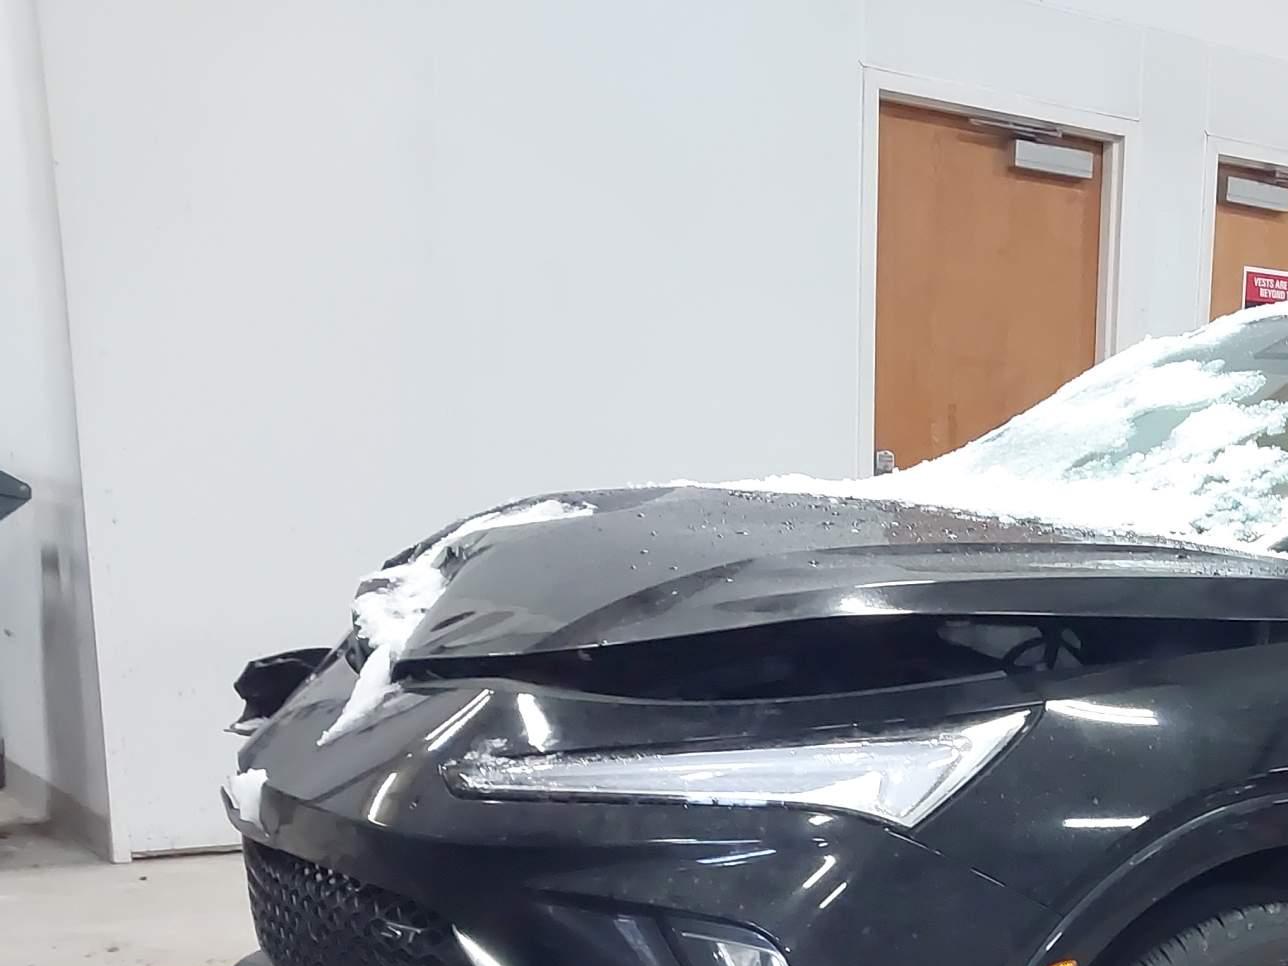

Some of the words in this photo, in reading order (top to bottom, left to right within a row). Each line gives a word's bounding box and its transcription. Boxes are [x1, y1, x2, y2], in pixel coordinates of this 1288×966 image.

[1254, 276, 1275, 288] VESTS
[1275, 280, 1288, 290] ARE
[1259, 288, 1286, 300] BEYOND
